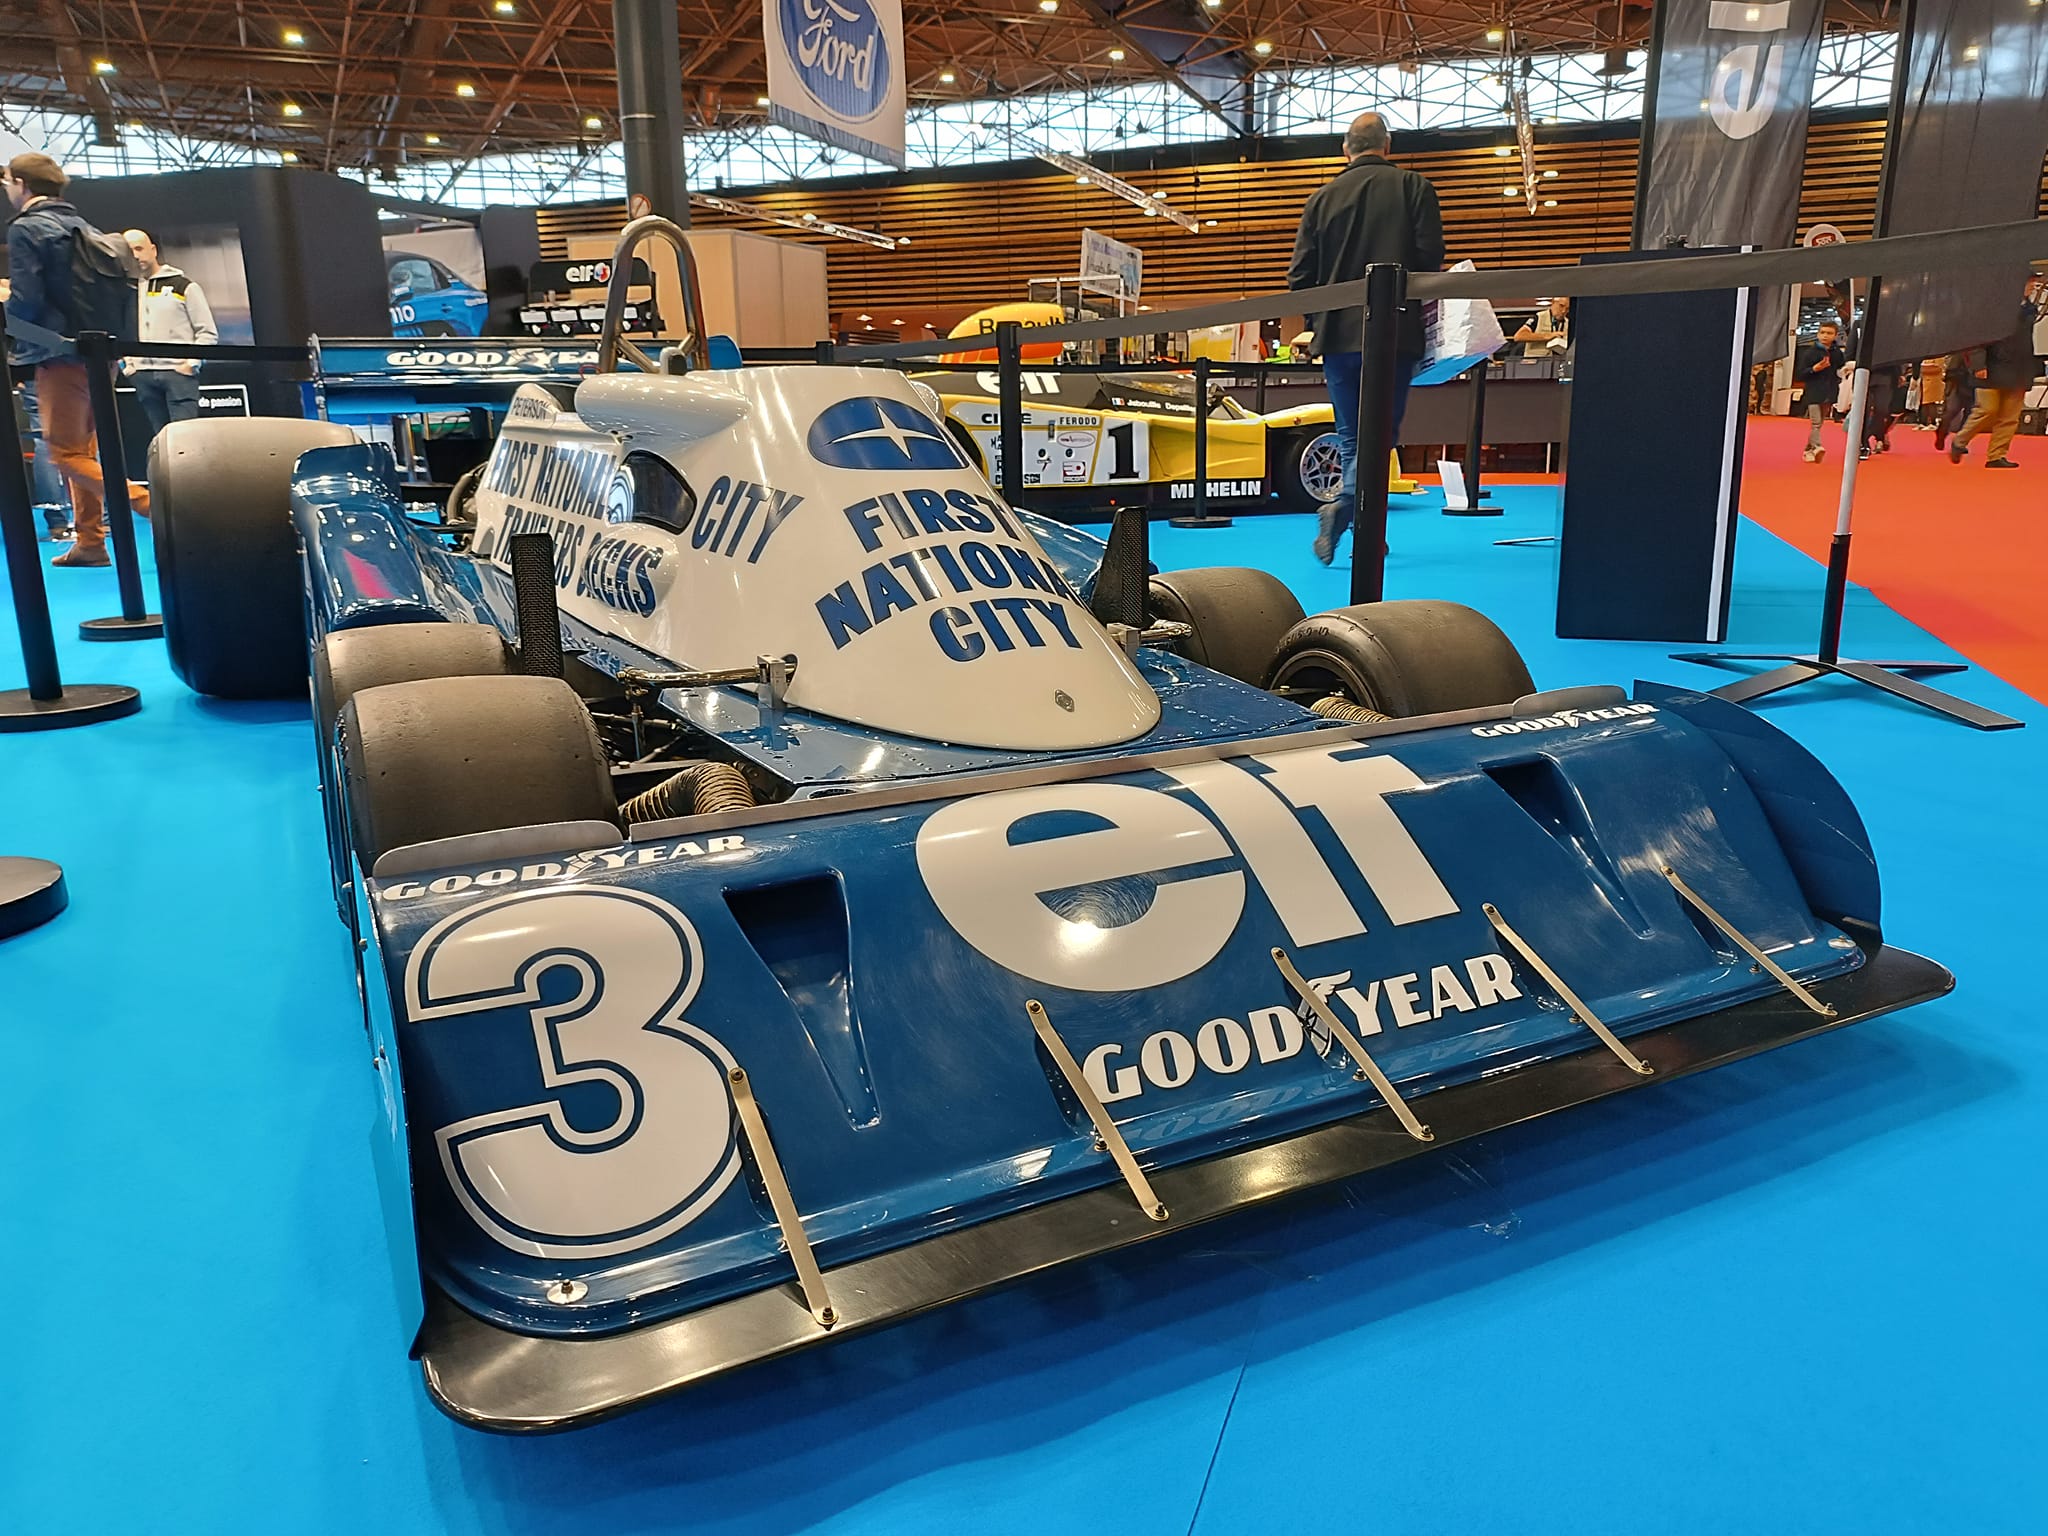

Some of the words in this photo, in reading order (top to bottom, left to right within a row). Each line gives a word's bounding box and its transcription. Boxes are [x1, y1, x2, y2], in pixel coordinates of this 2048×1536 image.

[798, 0, 874, 93] Ford
[1708, 0, 1791, 140] el
[565, 265, 594, 283] elf
[389, 304, 416, 324] 110
[981, 413, 1032, 424] CIE
[1059, 416, 1097, 425] FERODO
[1107, 421, 1140, 480] 1
[486, 437, 539, 500] FIRST
[529, 444, 618, 521] NATIONAL
[690, 475, 805, 564] CITY
[843, 488, 1022, 554] FIRST
[1170, 481, 1261, 499] MIHELIN
[814, 541, 1082, 651] NATIONA
[928, 597, 1084, 663] CITY
[915, 740, 1461, 992] elf
[404, 883, 743, 1260] 3
